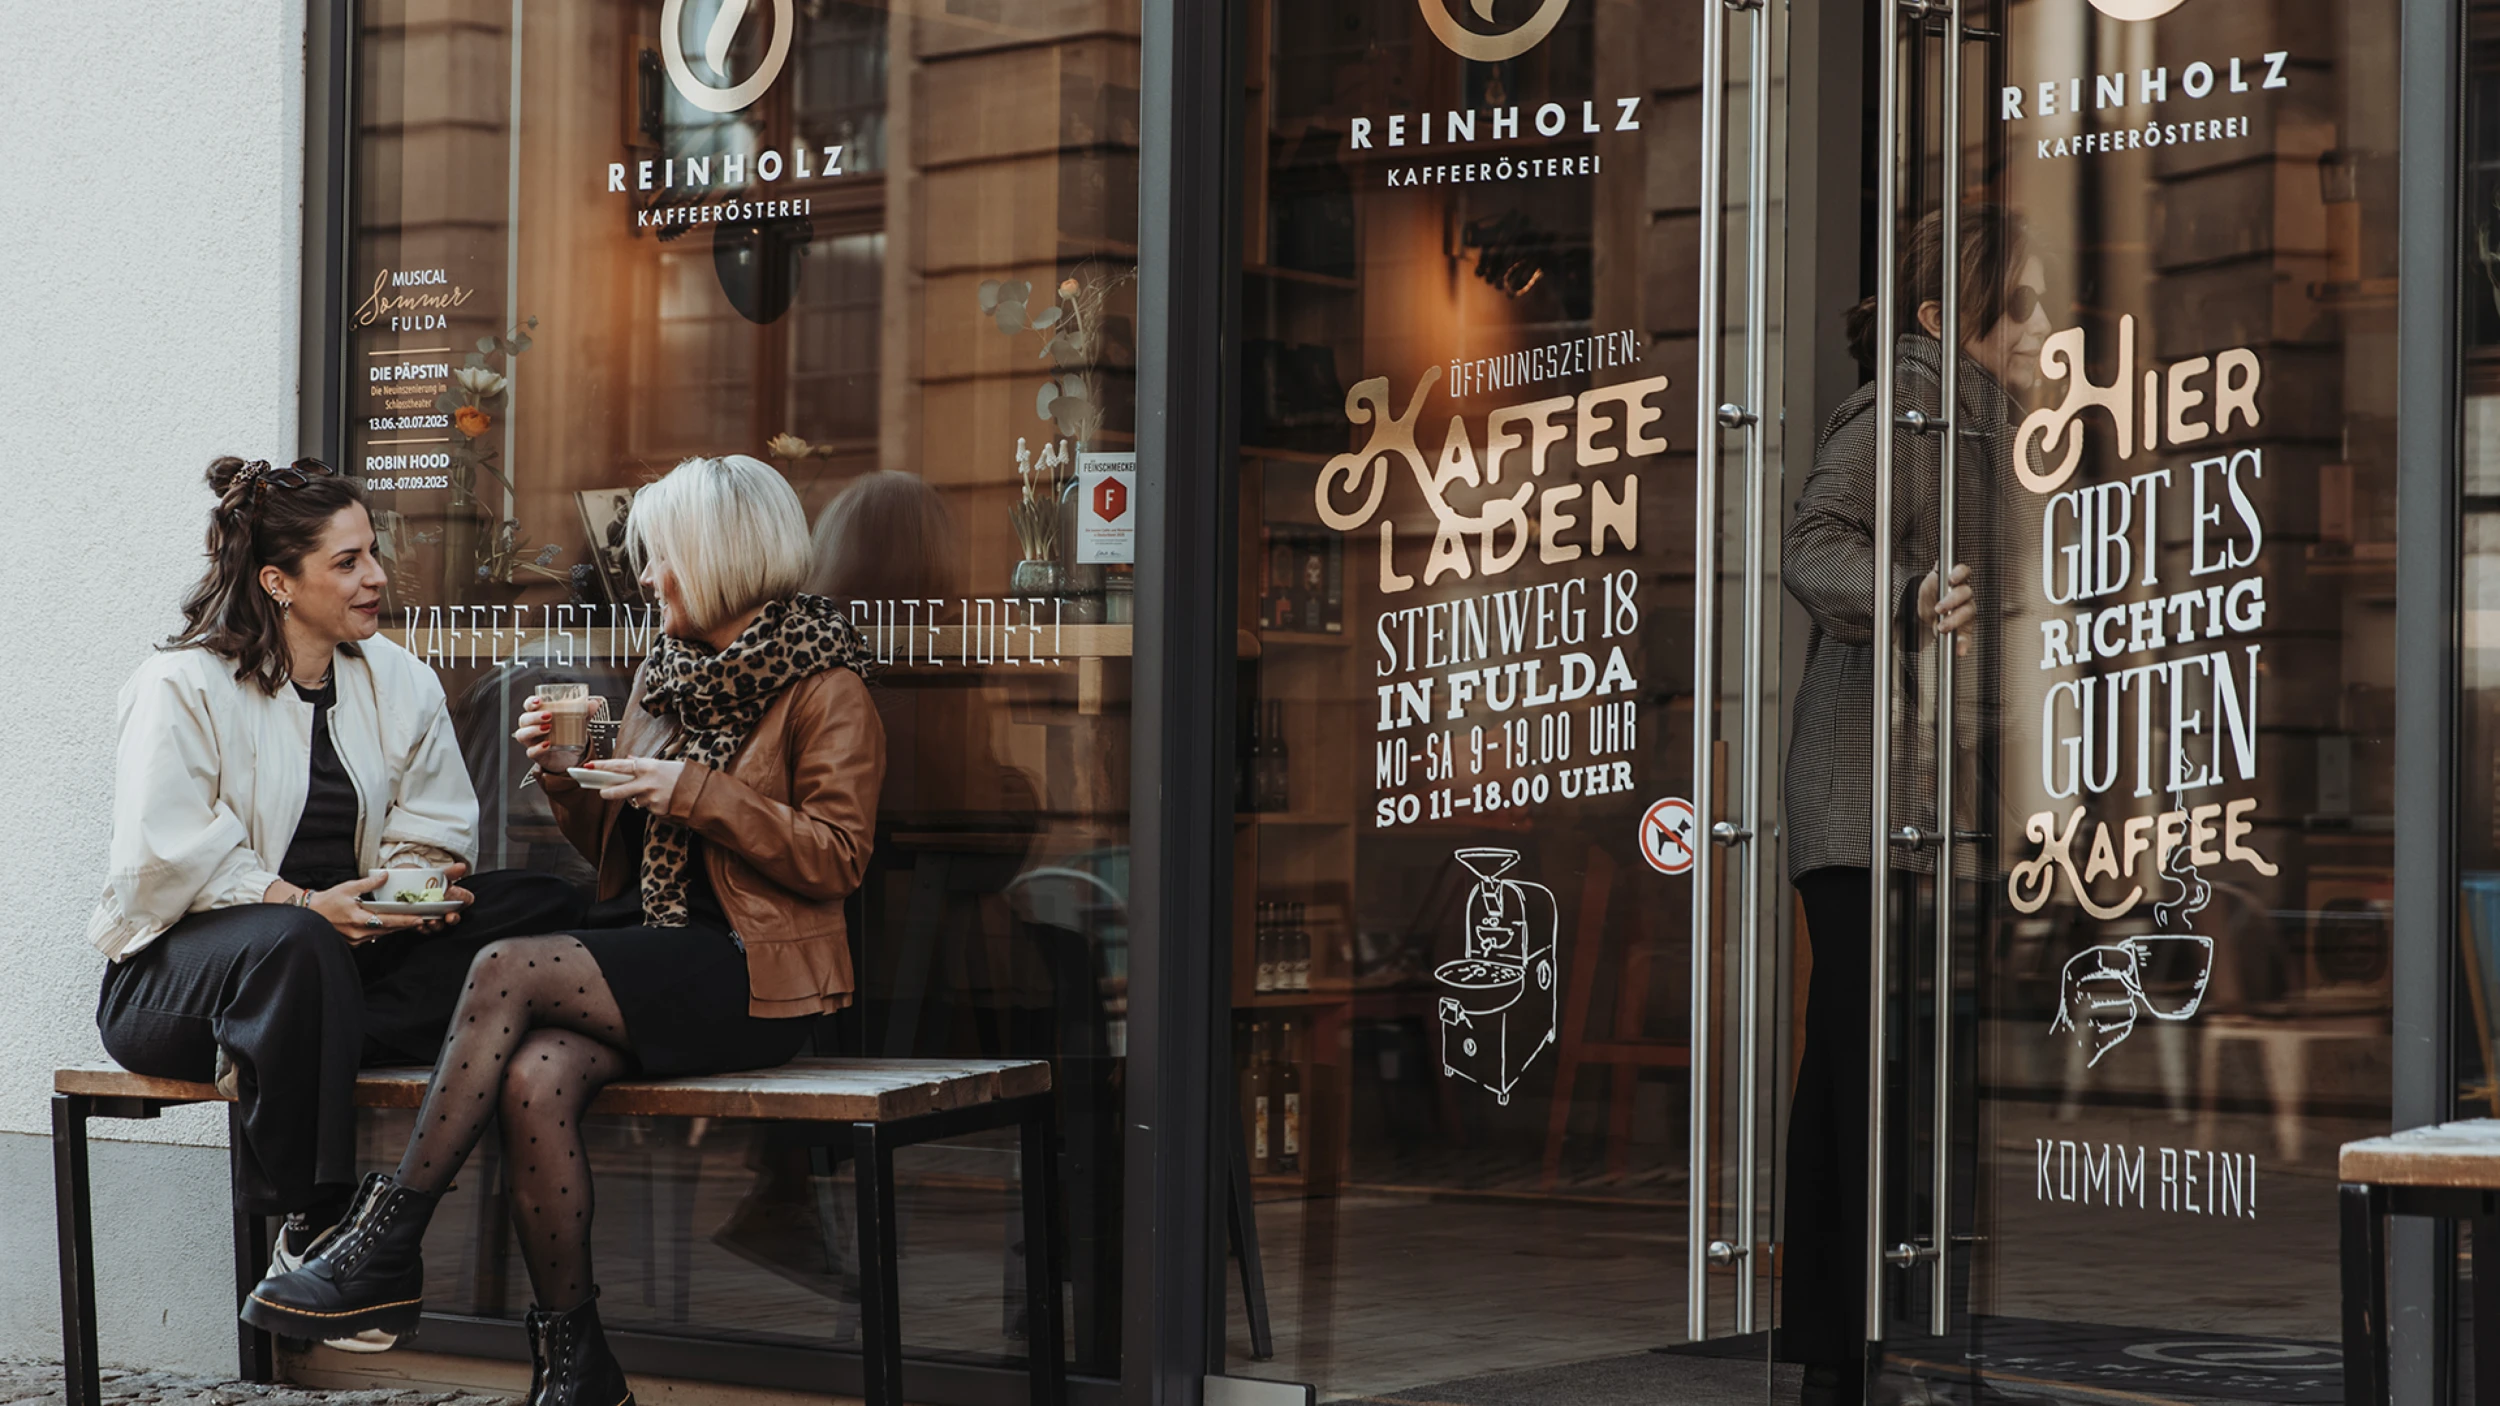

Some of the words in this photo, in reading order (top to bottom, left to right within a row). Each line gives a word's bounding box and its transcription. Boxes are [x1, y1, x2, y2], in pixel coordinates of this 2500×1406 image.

[2002, 51, 2289, 121] REINHOLZ
[1351, 97, 1642, 151] REINHOLZ
[2038, 115, 2248, 159] KAFFEERÖSTEREI
[608, 144, 843, 193] REINHOLZ
[1387, 155, 1601, 187] KAFFEERÖSTEREI
[638, 198, 811, 227] KAFFEERÖSTEREI
[350, 268, 474, 328] Sommer
[392, 269, 447, 287] MUSICAL
[391, 314, 447, 331] FULDA
[370, 366, 392, 381] DIE
[394, 362, 449, 380] PÄPSTIN
[370, 386, 383, 396] Die
[438, 382, 448, 392] im
[1450, 328, 1642, 399] ÖFFNUNGSZEITEN:
[369, 415, 449, 430] 13.06.-20.07.2025
[2013, 314, 2260, 494] HIER
[366, 455, 407, 470] ROBIN
[409, 453, 450, 468] HOOD
[367, 476, 449, 490] 01.08.-07.09.2025
[1315, 365, 1669, 533] KAFFEE
[1105, 488, 1116, 511] F
[2042, 469, 2171, 605] GIBT
[2190, 448, 2263, 576] ES
[1379, 474, 1639, 594] LADEN
[403, 604, 530, 669] KAFFEE
[543, 603, 597, 669] IST
[960, 597, 1061, 667] IDEE!
[1377, 577, 1586, 677] STEINWEG
[1601, 569, 1639, 639] 18
[2040, 576, 2267, 670] RICHTIG
[1377, 677, 1434, 731] IN
[1447, 646, 1638, 720] FULDA
[2042, 644, 2262, 800] GUTEN
[1376, 730, 1454, 790] MO-SA
[1470, 710, 1571, 776] 9-19.00
[1589, 701, 1637, 756] UHR
[1376, 793, 1421, 828] SO
[1430, 773, 1549, 820] 11-18.00
[1559, 760, 1635, 799] UHR
[2008, 797, 2279, 920] KAFFEE
[2036, 1138, 2145, 1209] KOMM
[2159, 1147, 2257, 1220] REIN!
